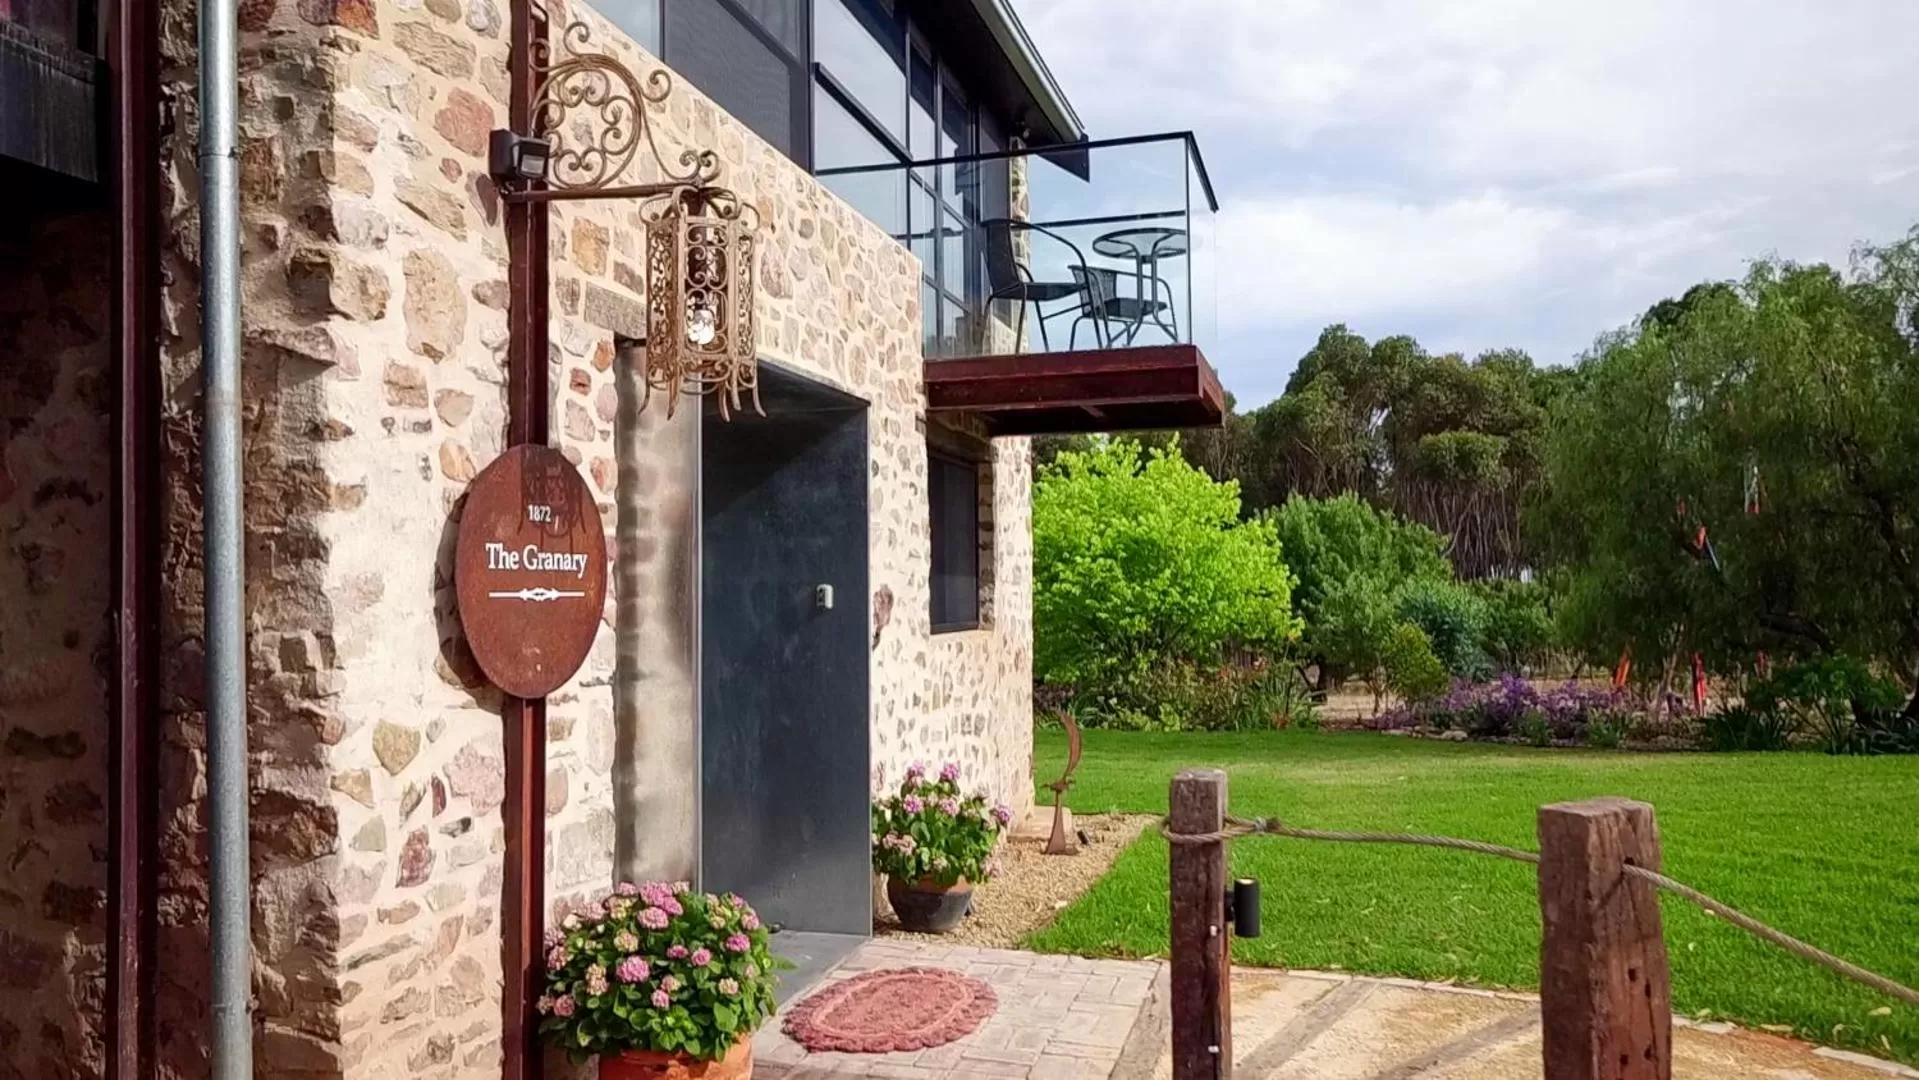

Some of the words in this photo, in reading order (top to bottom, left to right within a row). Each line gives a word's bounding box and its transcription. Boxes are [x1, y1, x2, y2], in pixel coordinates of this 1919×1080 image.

[528, 504, 552, 522] 1872
[485, 542, 519, 569] The
[523, 544, 588, 579] Granary
